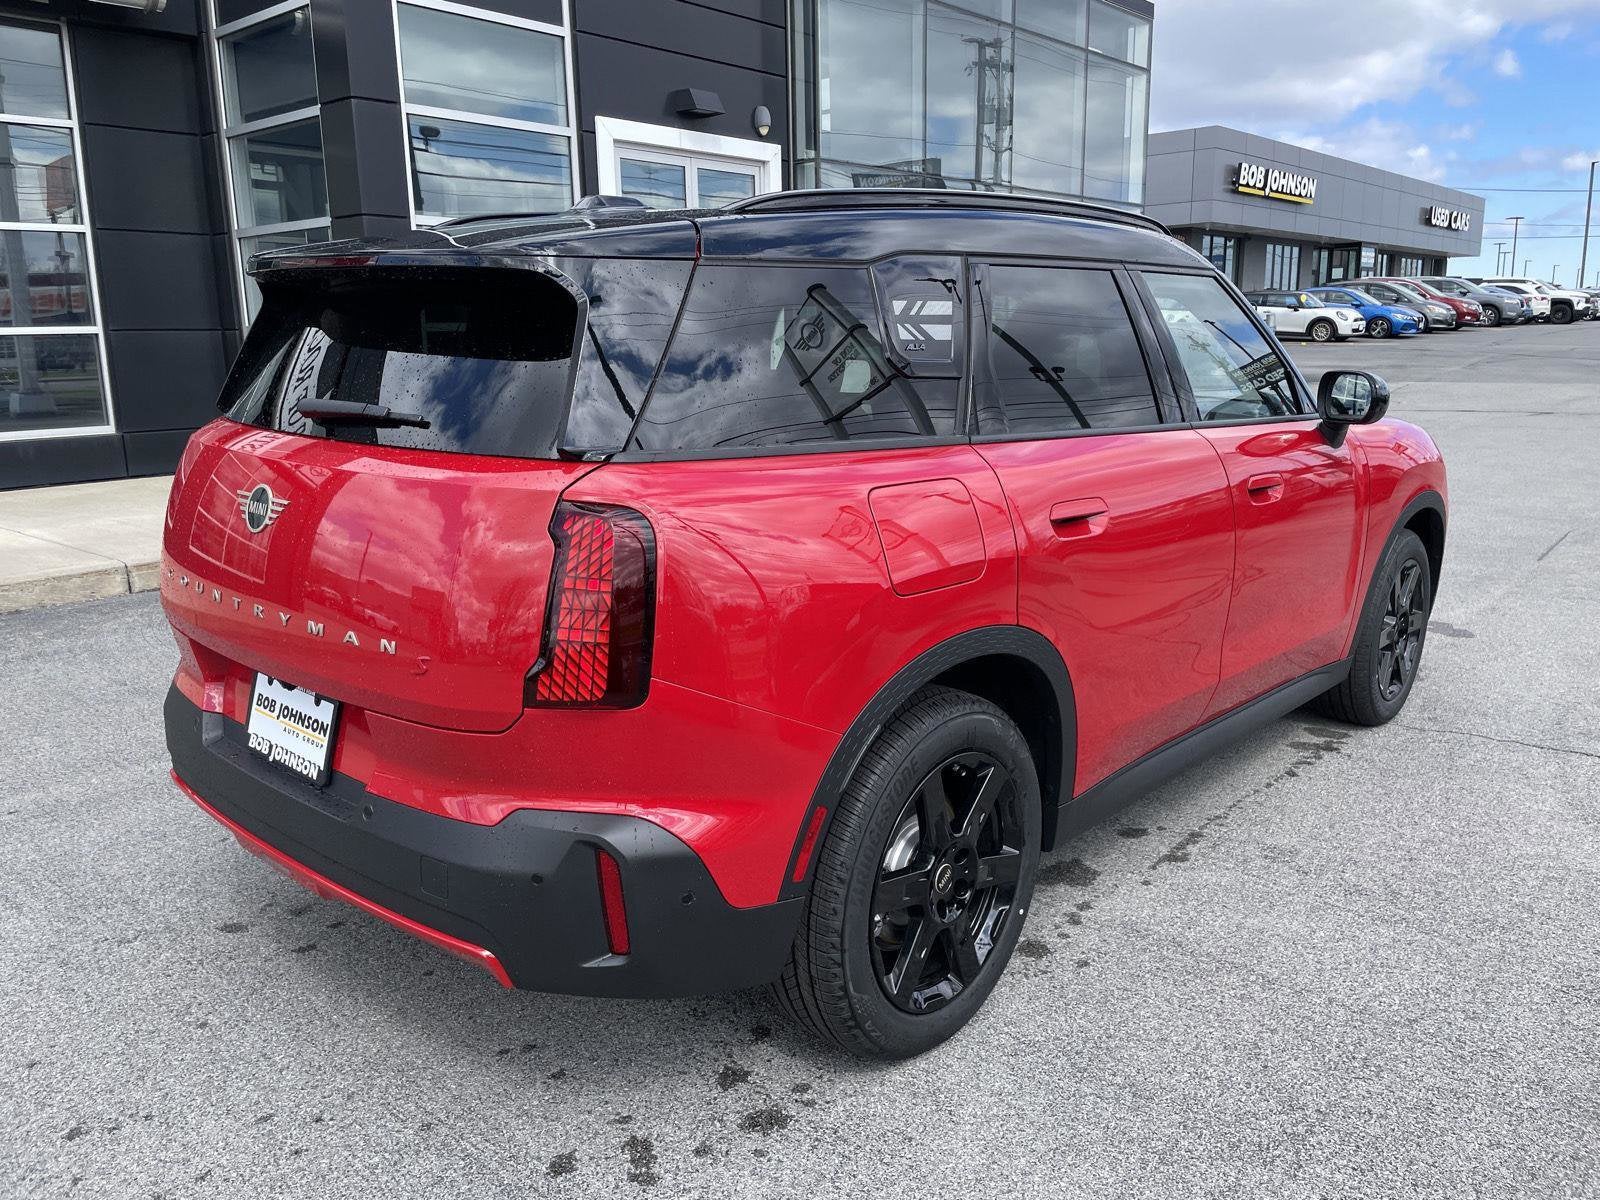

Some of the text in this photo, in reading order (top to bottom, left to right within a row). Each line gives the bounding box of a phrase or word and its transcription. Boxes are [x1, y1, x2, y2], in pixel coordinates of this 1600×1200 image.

[1239, 162, 1317, 198] BOB JOHNSON
[1431, 206, 1470, 231] USED CARS
[248, 500, 269, 517] MINI
[410, 655, 432, 676] S
[255, 693, 330, 738] BOB JOHNSON
[283, 727, 324, 749] AUTO GROUP
[248, 733, 320, 780] BOB JOHNSON
[938, 868, 952, 890] MINI
